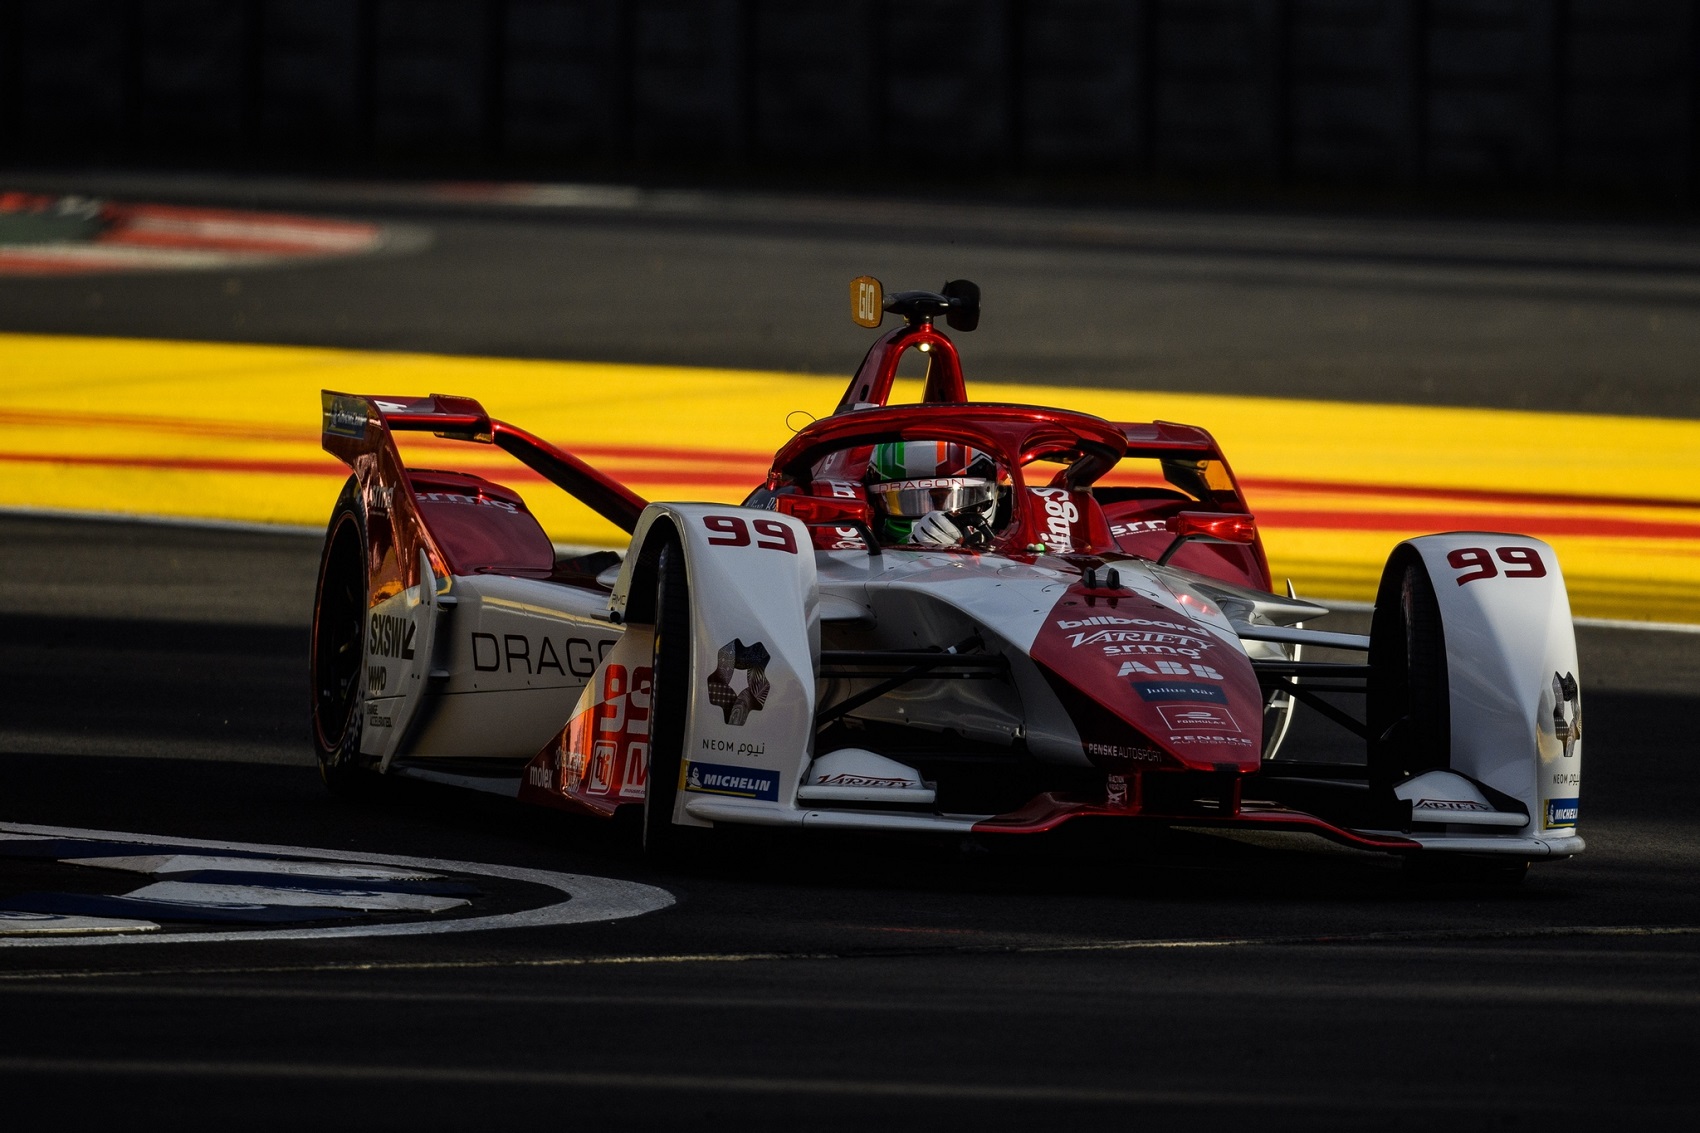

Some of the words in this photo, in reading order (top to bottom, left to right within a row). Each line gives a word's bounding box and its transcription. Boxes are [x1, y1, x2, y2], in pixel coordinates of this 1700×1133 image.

[859, 283, 875, 320] GIO
[878, 477, 965, 494] DRAGON
[702, 515, 798, 555] 99
[1446, 546, 1547, 587] 99
[370, 612, 404, 659] SXSW
[1056, 616, 1212, 636] billboard
[1064, 629, 1216, 653] VARIETY
[472, 632, 618, 678] DRAG
[1117, 660, 1224, 681] ABB
[1146, 687, 1187, 695] Julius
[702, 738, 734, 751] NEOM
[737, 741, 766, 757] نيوم
[1169, 735, 1253, 744] PENSKE
[1088, 742, 1118, 757] PENSKE
[1118, 748, 1163, 763] AUTOSPORT
[529, 760, 554, 790] molex
[703, 772, 772, 792] MICHELIN
[817, 773, 918, 788] VARIETY
[1552, 773, 1568, 785] NEOM
